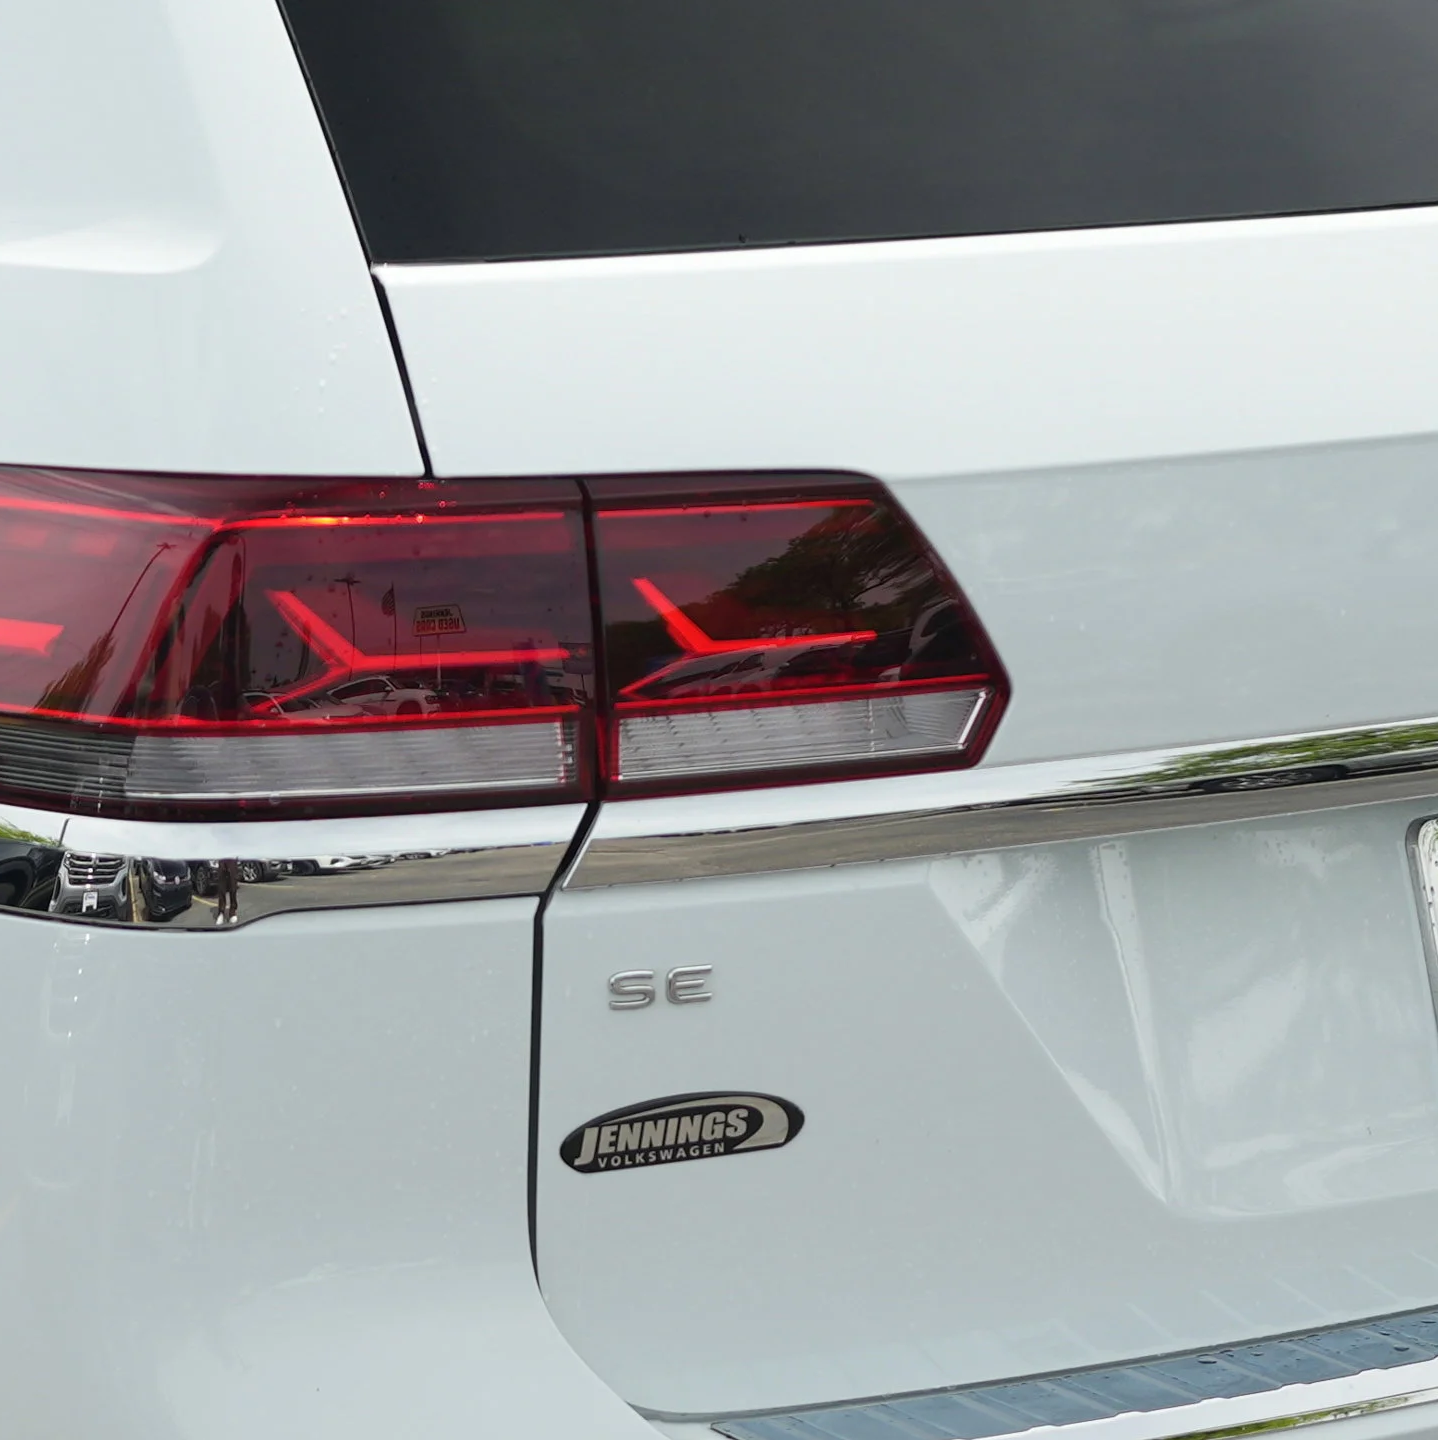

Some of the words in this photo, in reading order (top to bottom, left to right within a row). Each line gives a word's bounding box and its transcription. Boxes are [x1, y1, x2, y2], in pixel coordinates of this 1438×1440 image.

[609, 964, 712, 1010] SE
[574, 1108, 749, 1166] JENNINGS
[598, 1142, 725, 1169] VOLKSWAGEN
